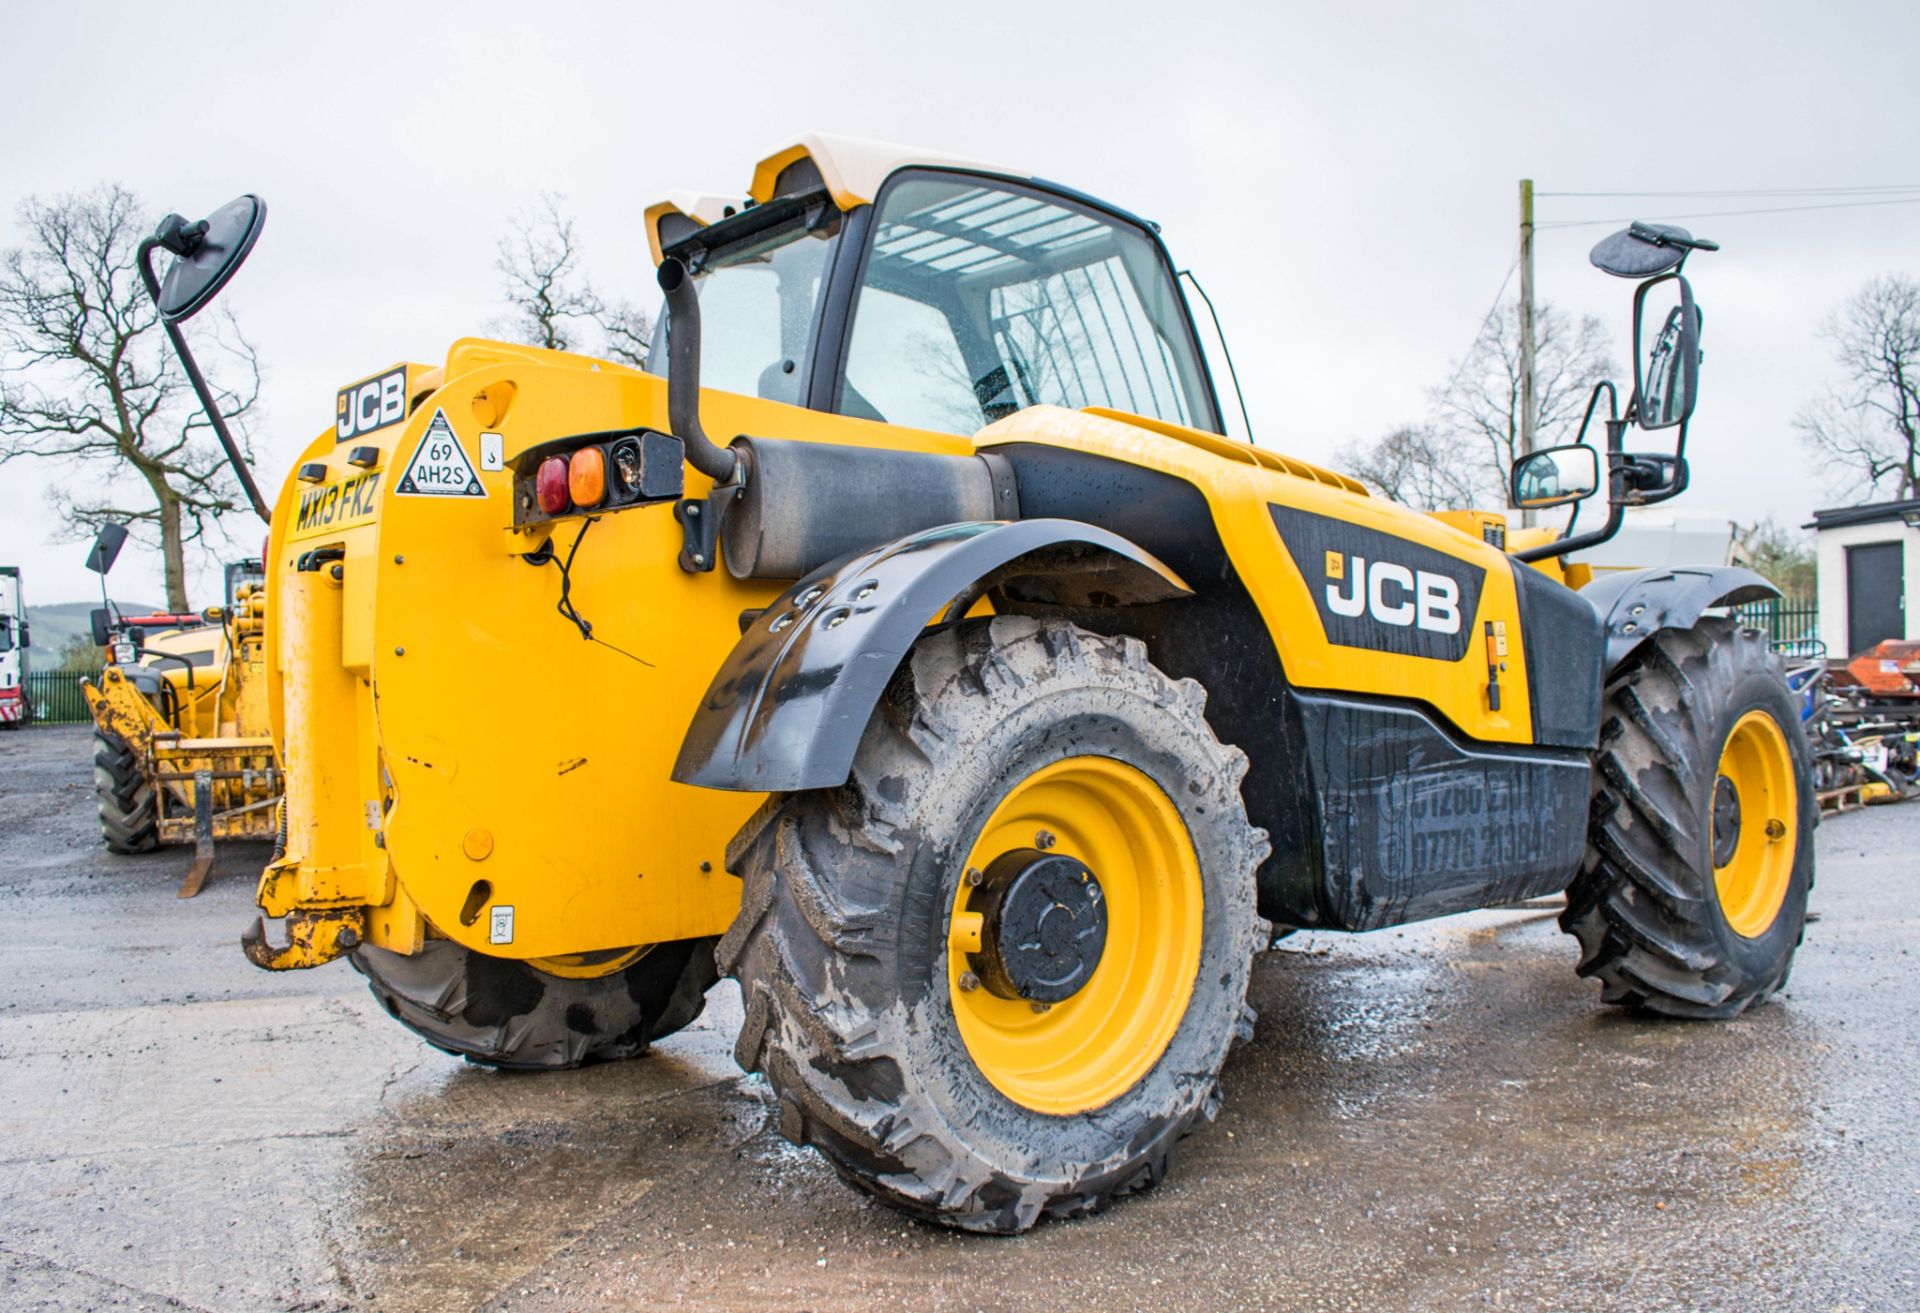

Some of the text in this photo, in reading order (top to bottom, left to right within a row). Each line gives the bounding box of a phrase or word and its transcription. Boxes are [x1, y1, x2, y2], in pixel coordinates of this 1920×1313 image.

[338, 372, 405, 438] JCB
[417, 464, 464, 485] AH2S
[430, 443, 452, 462] 69
[296, 473, 380, 531] MX13 FKZ
[1326, 556, 1461, 634] JCB
